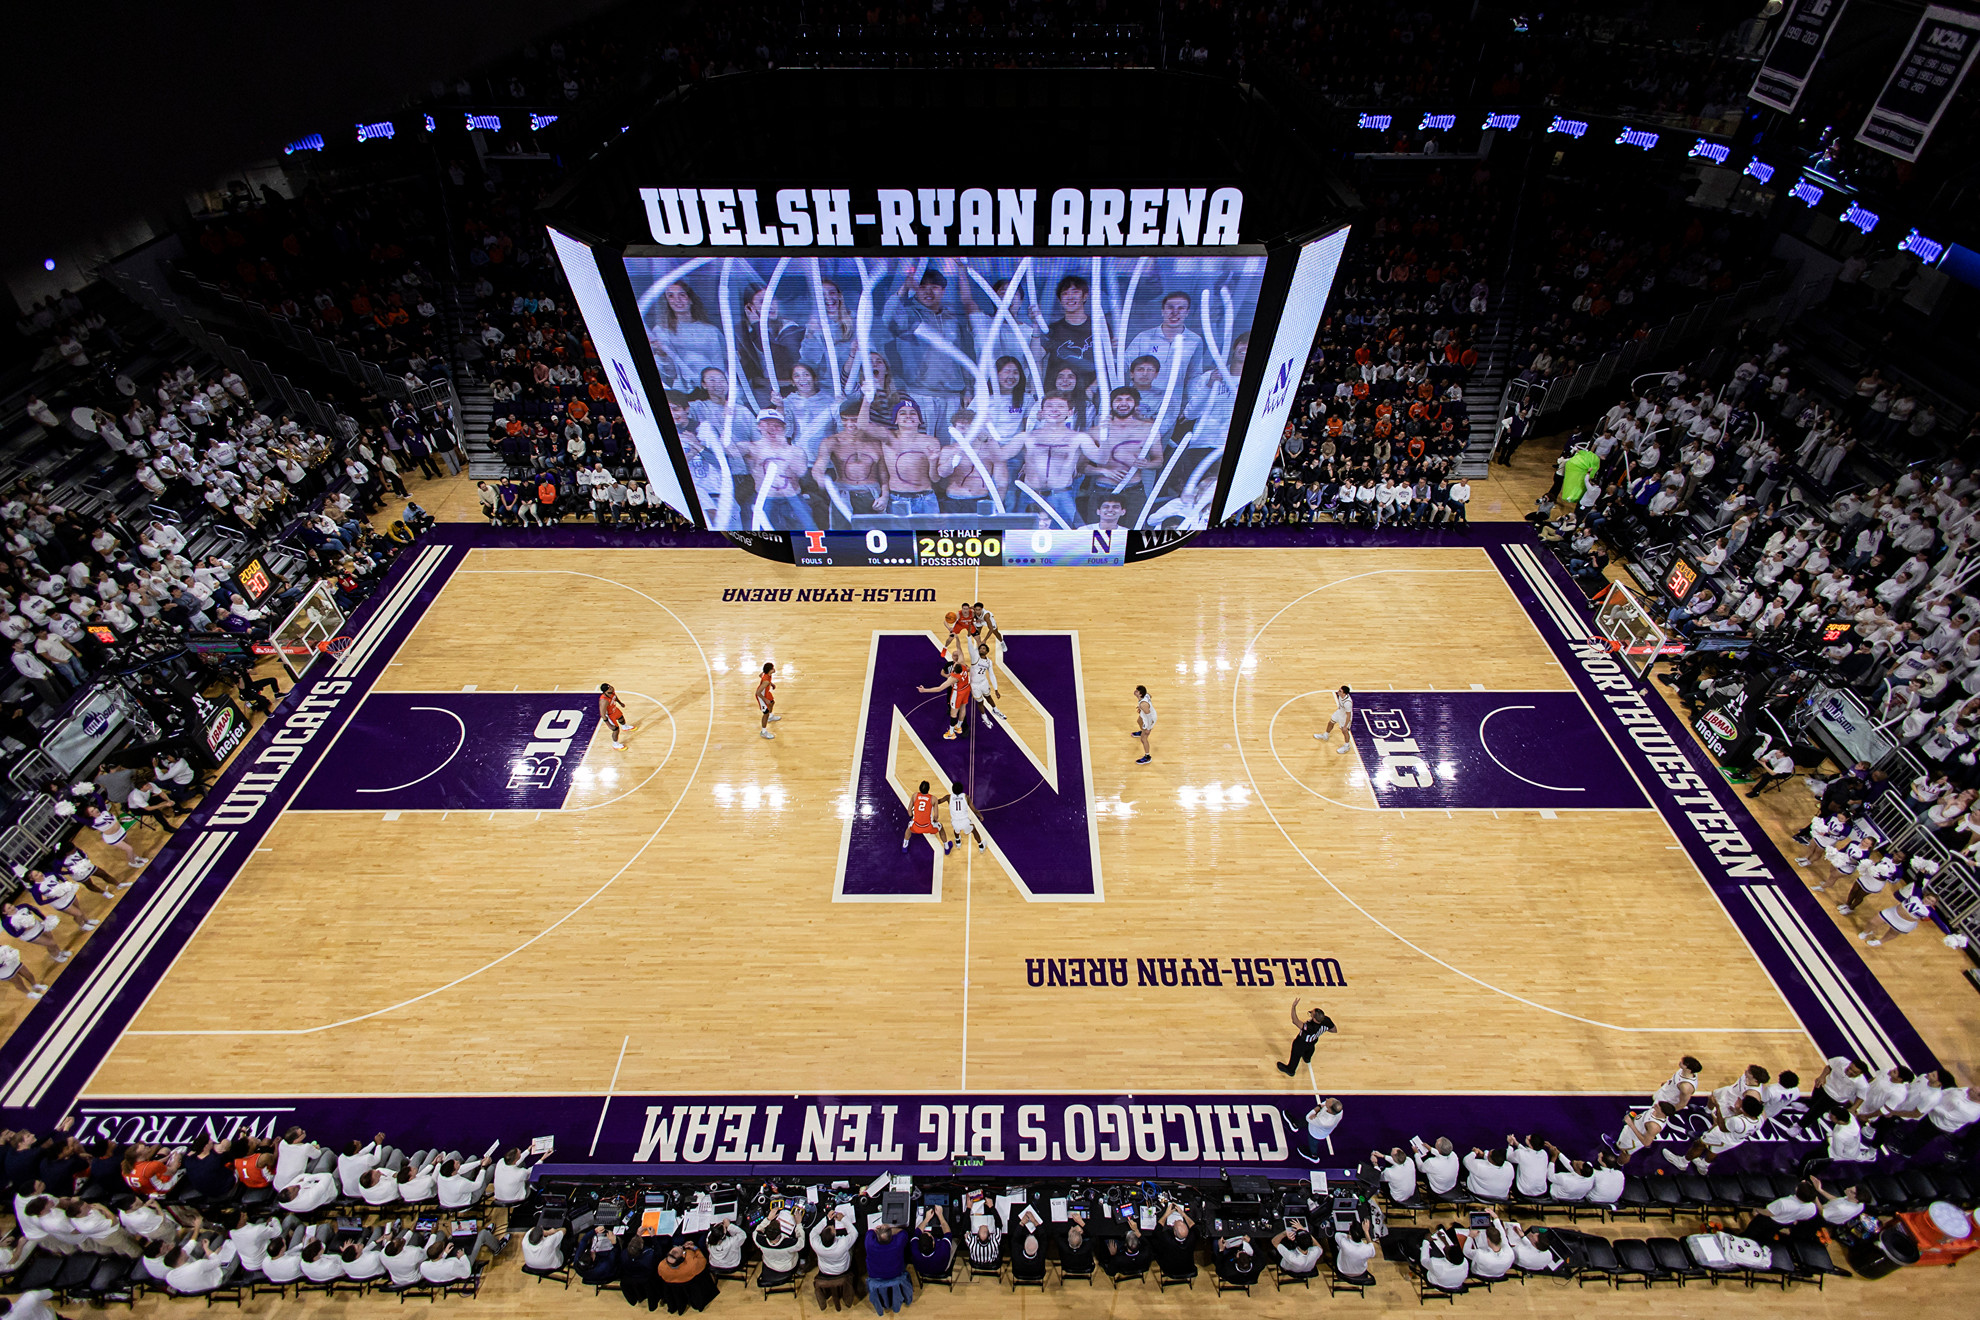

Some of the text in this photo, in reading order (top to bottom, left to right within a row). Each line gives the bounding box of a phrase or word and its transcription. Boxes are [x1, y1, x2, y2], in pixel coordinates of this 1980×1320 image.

[640, 187, 1244, 247] WELSH-RYAN ARENA
[866, 530, 888, 554] 0
[938, 530, 981, 538] 1ST HALF
[1031, 530, 1052, 554] 0
[1140, 530, 1192, 548] WIN
[919, 538, 1000, 557] 20:00
[239, 559, 262, 584] 20:00
[827, 557, 833, 565] 0
[920, 558, 980, 566] POSSESSION
[1674, 558, 1698, 583] 20:00
[246, 572, 269, 599] 30
[722, 588, 937, 602] WELSH-RYAN ARENA
[1667, 570, 1690, 598] 30
[1823, 630, 1841, 641] 30
[207, 709, 232, 752] LIBMAN
[1702, 709, 1736, 738] LIBMAN
[214, 721, 247, 762] meijer
[1695, 719, 1727, 757] meijer
[206, 680, 353, 826] WILDCATS
[1568, 642, 1776, 880] NORTHWESTERN
[917, 801, 926, 811] 2
[955, 800, 962, 811] 11
[1024, 957, 1348, 987] WELSH-RYAN ARENA
[73, 1115, 278, 1145] WINTRUST
[632, 1103, 1290, 1163] CHICAGO'S BIG TEN TEAM
[125, 1175, 142, 1188] 15
[242, 1167, 250, 1179] 1
